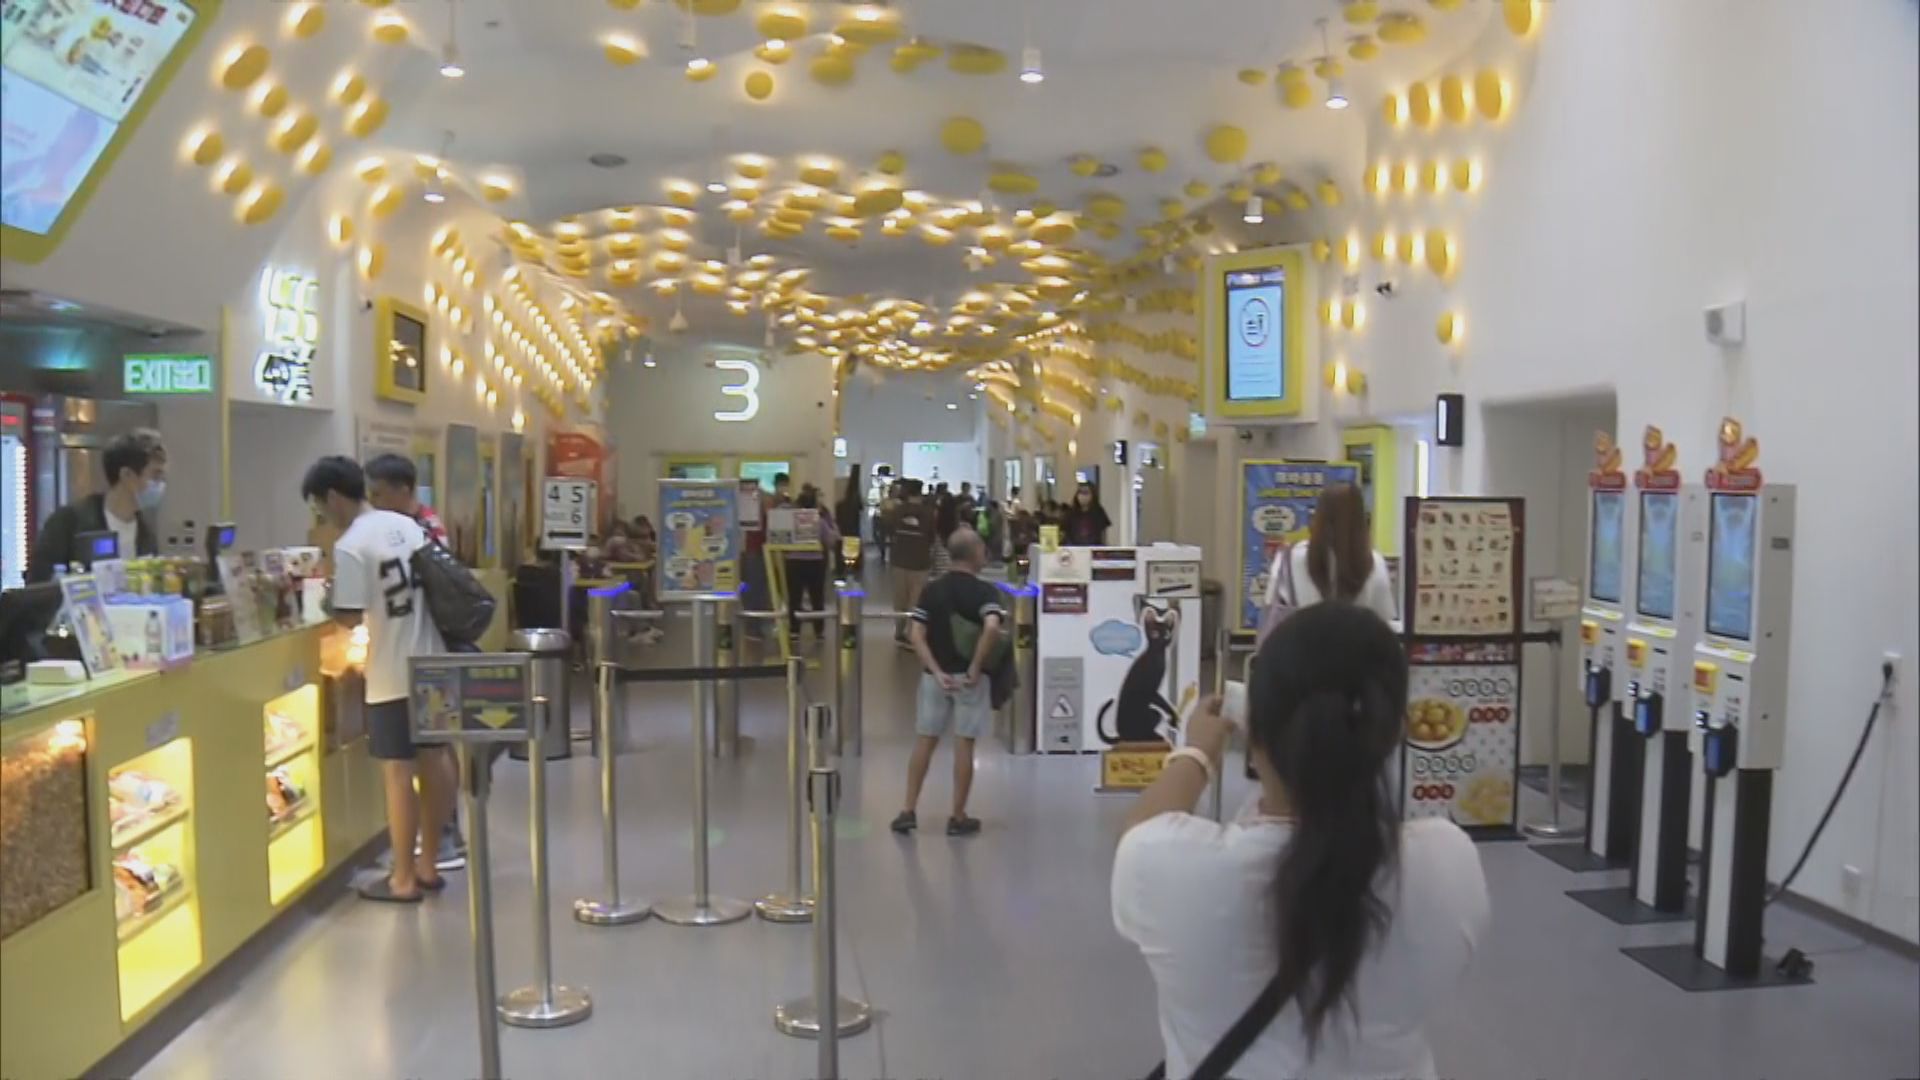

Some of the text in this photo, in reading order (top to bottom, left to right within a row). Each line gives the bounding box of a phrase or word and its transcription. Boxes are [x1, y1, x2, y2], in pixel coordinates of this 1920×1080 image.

[126, 360, 174, 389] EXIT
[714, 359, 760, 421] 3
[548, 485, 583, 503] 4 5
[571, 508, 583, 525] 6
